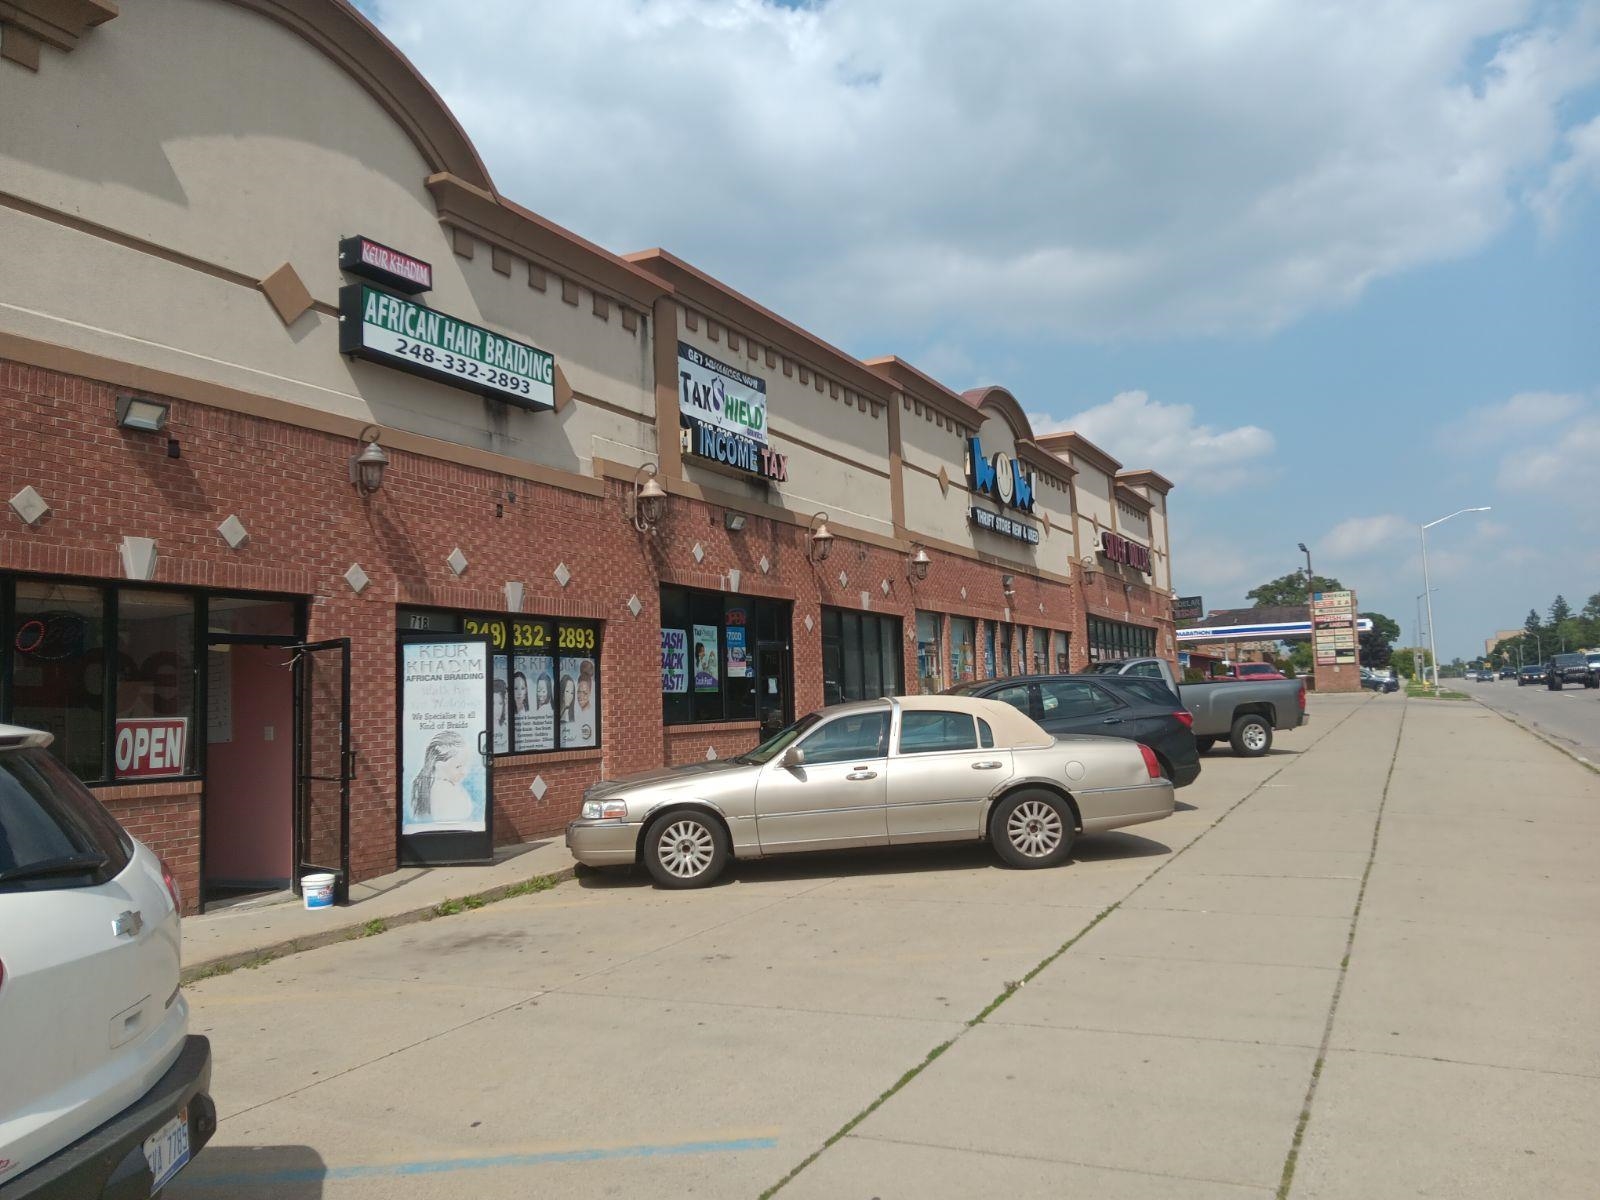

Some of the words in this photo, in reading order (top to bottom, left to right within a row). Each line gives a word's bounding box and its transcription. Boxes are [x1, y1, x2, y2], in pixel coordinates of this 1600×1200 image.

[362, 242, 388, 269] KEUR
[364, 292, 439, 345] AFRICAN
[444, 321, 481, 359] HAIR
[485, 333, 553, 383] BRAIDING
[395, 338, 531, 394] 248-332-2893
[688, 348, 703, 365] GET
[699, 426, 758, 472] INCOME
[761, 447, 788, 482] TAX
[976, 509, 995, 528] THRIFT
[996, 517, 1011, 534] STORE
[410, 614, 429, 630] 718
[558, 626, 595, 649] 2893
[406, 674, 442, 682] AFRICAN
[443, 672, 484, 681] BRAIDING
[115, 727, 182, 771] OPEN
